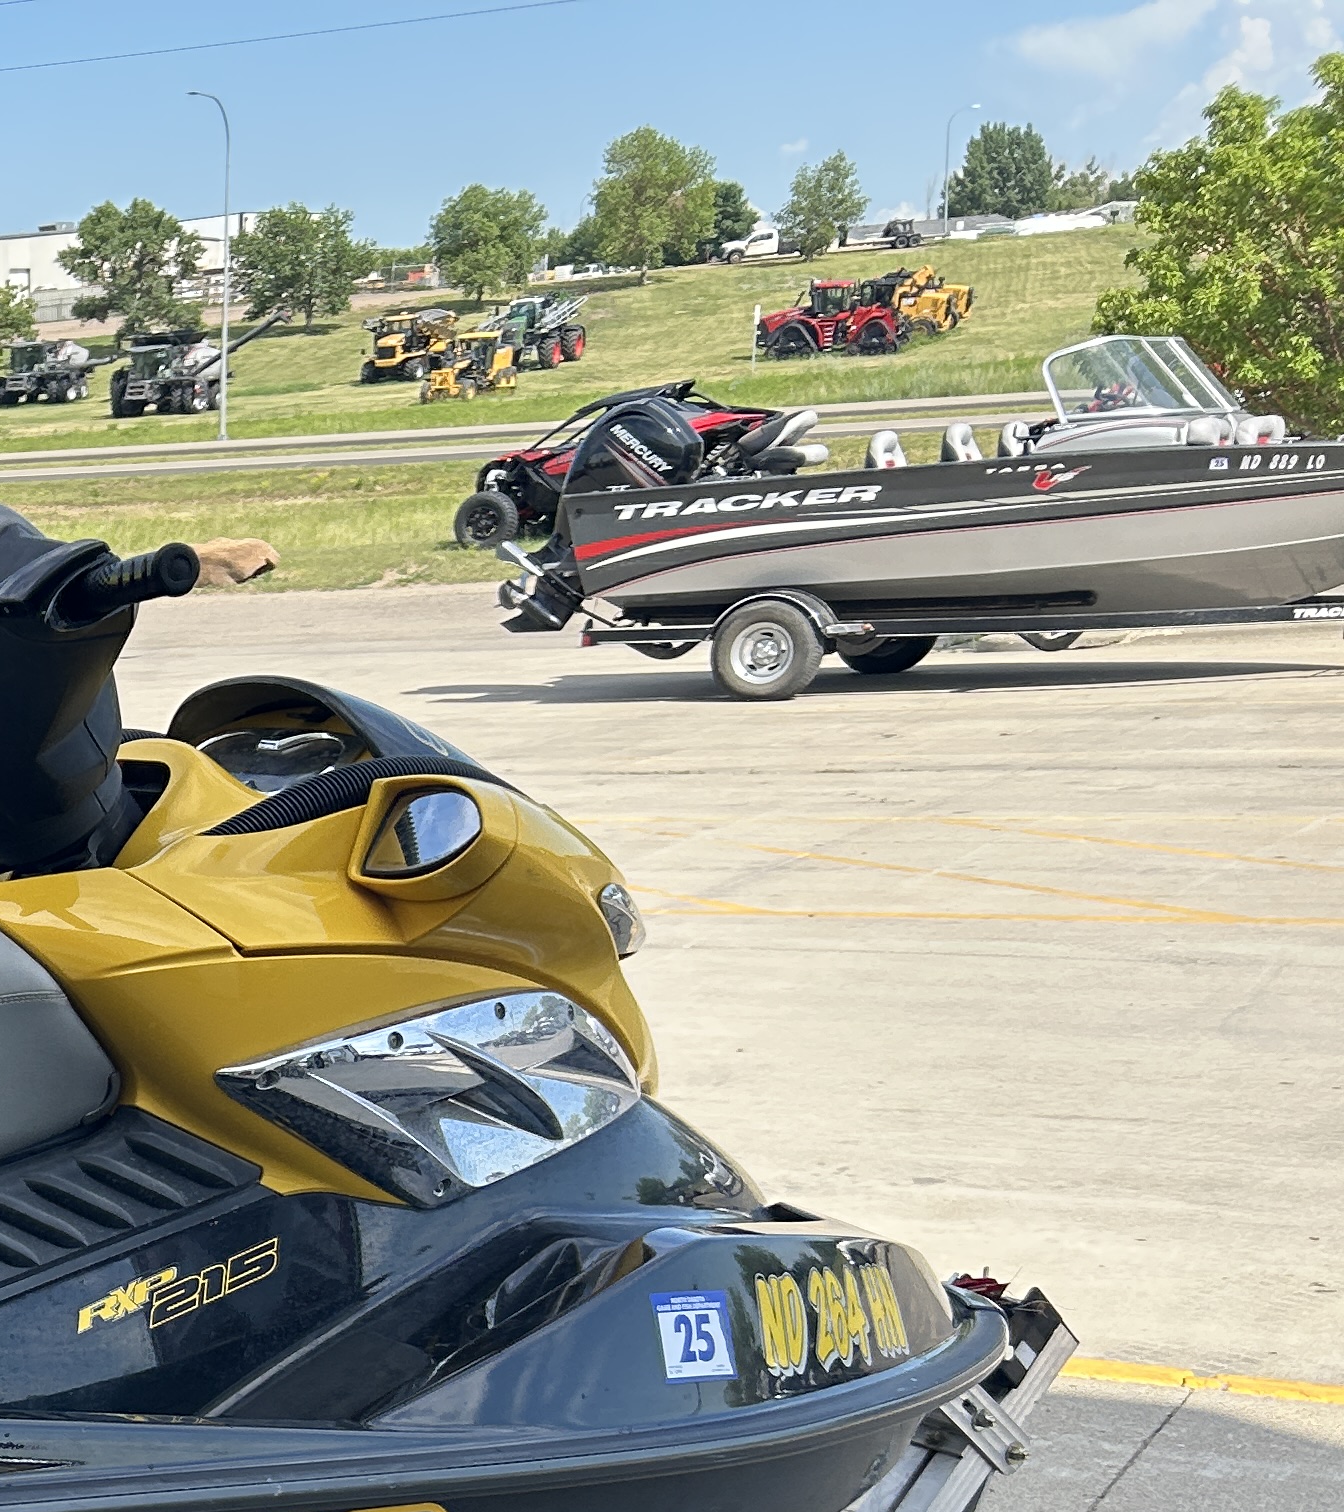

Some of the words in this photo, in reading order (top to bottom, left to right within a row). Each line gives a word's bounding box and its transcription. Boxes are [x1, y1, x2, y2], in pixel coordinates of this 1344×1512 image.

[610, 424, 673, 472] MERCURY
[1268, 453, 1300, 471] 889
[613, 484, 883, 522] TRACKER
[1293, 606, 1344, 619] TRAC
[77, 1265, 179, 1335] RXP
[148, 1235, 280, 1329] 215
[673, 1312, 717, 1364] 25
[755, 1271, 809, 1378] ND
[807, 1264, 873, 1374] 264
